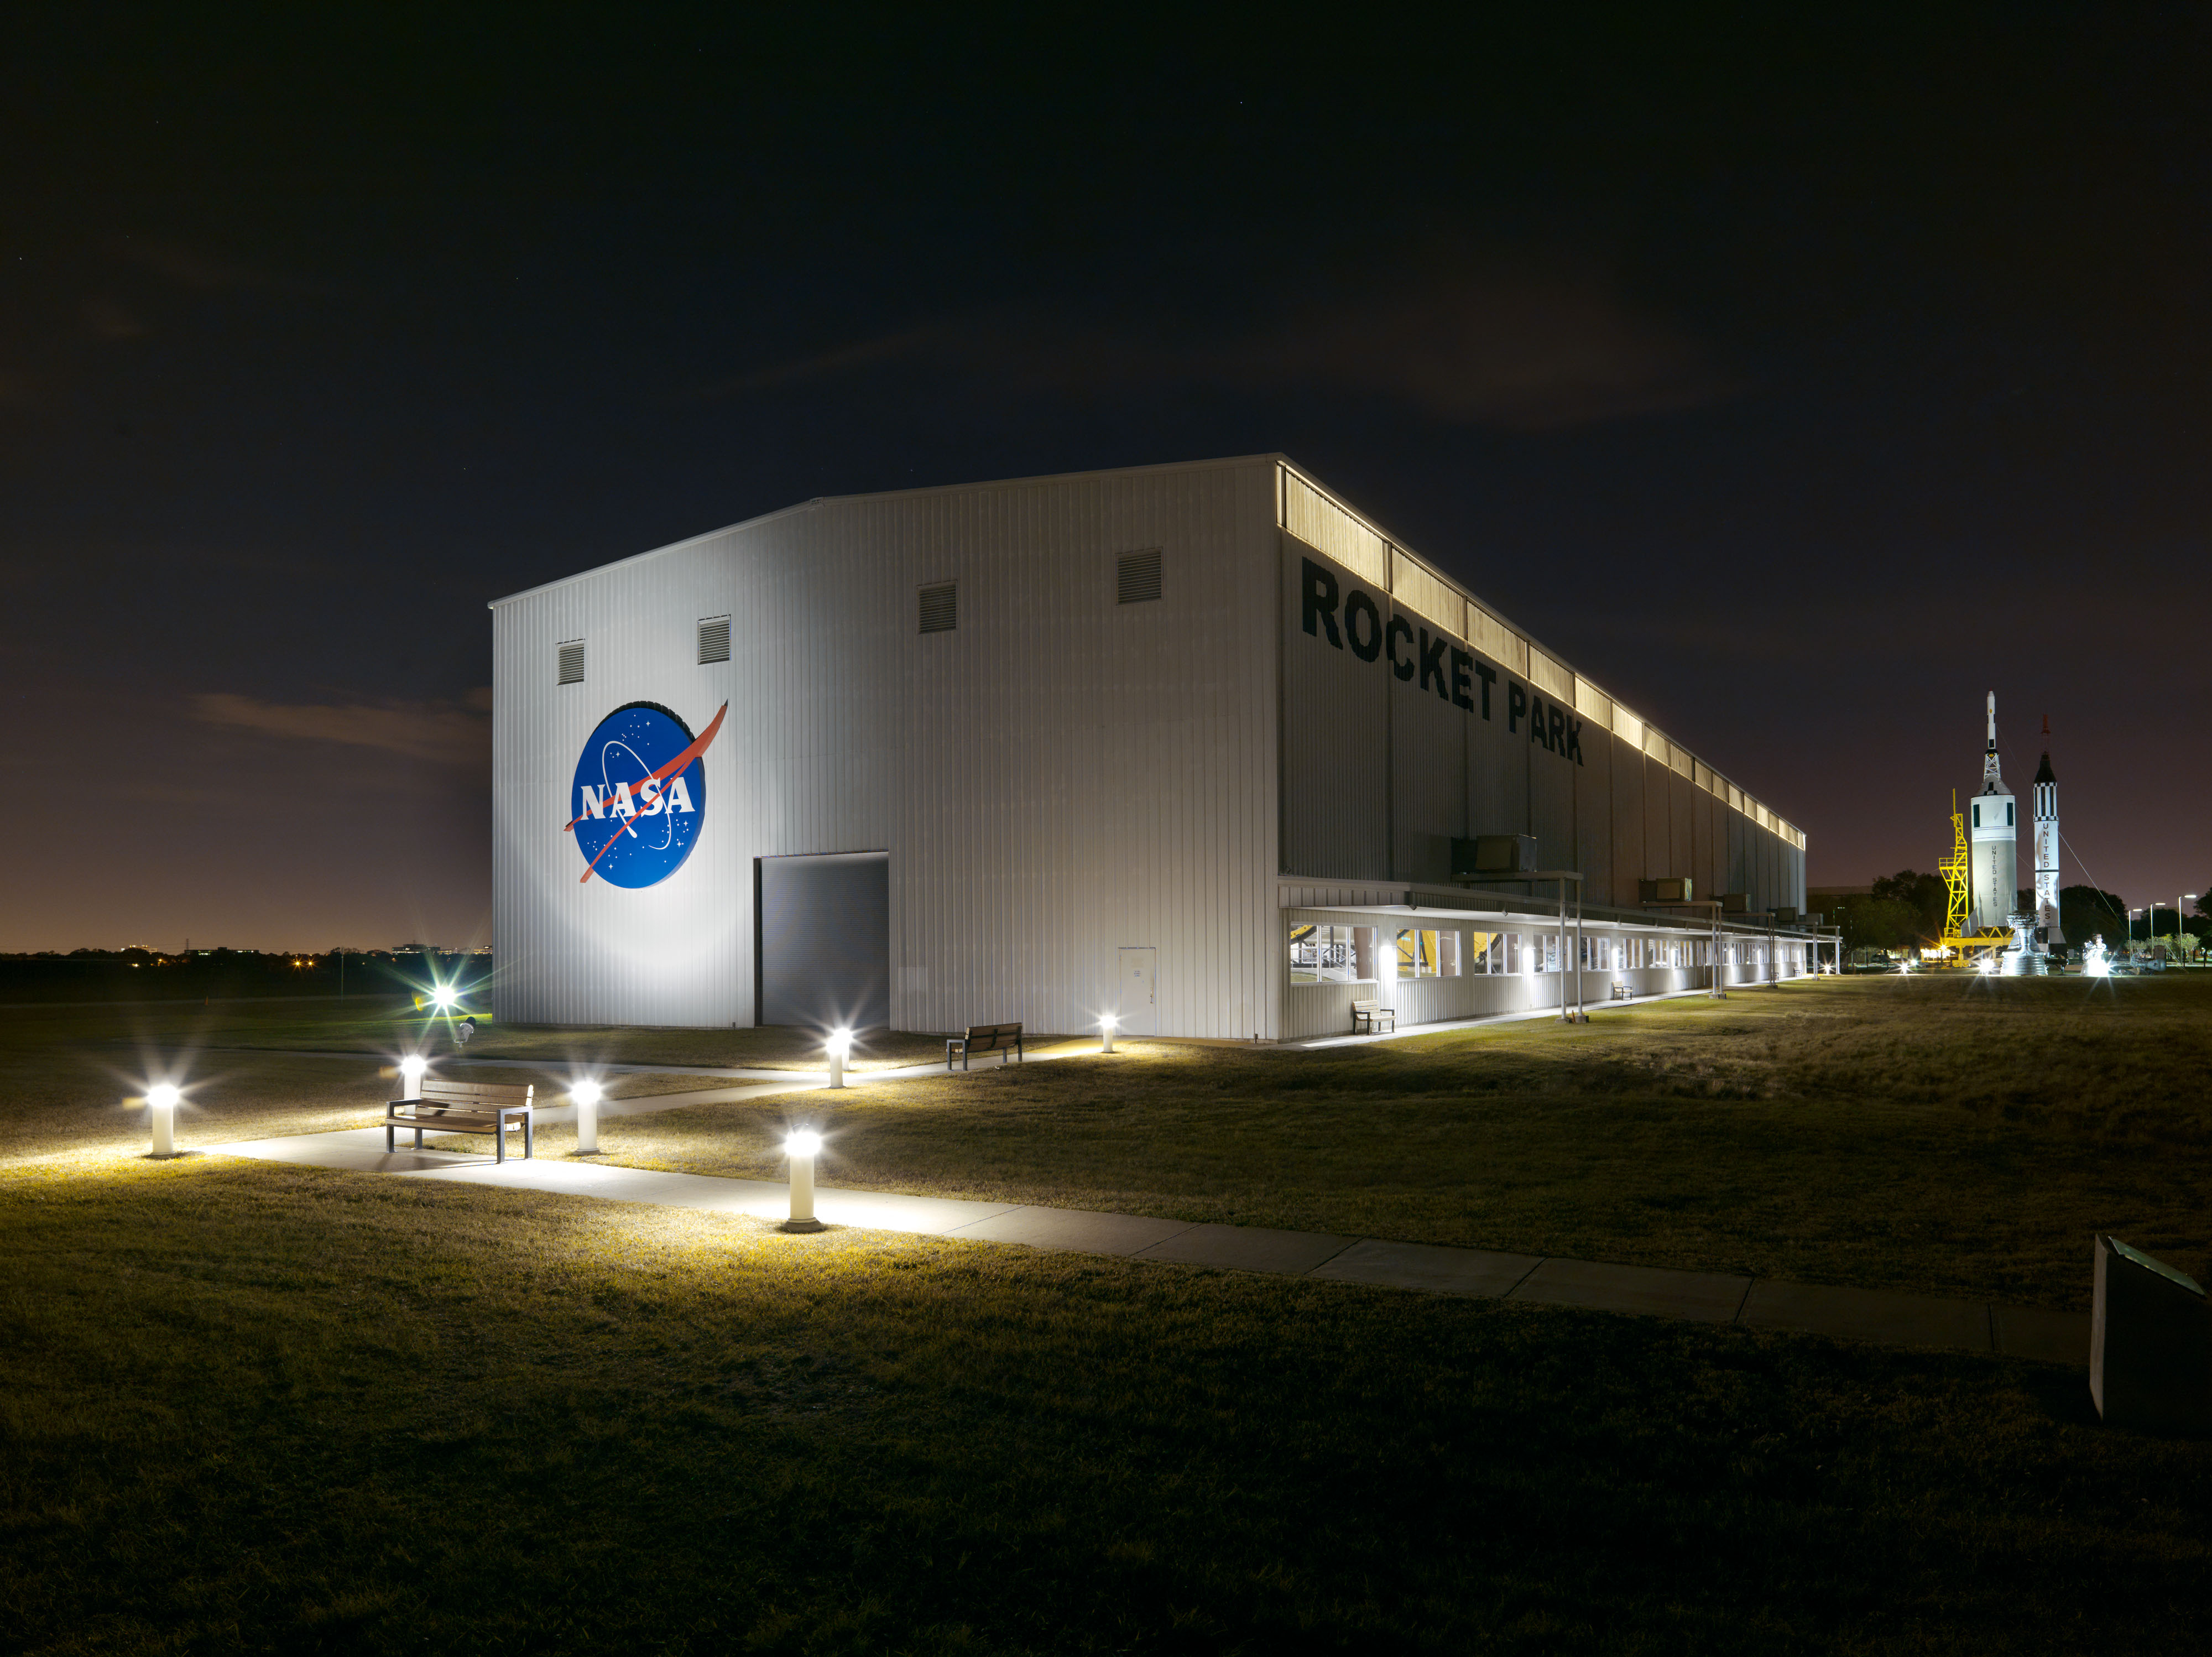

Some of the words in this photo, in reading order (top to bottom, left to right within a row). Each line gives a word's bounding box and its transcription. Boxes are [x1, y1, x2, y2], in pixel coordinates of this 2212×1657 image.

[1302, 556, 1496, 721] ROCKET
[1508, 680, 1584, 767] PARK
[580, 776, 696, 821] NASA
